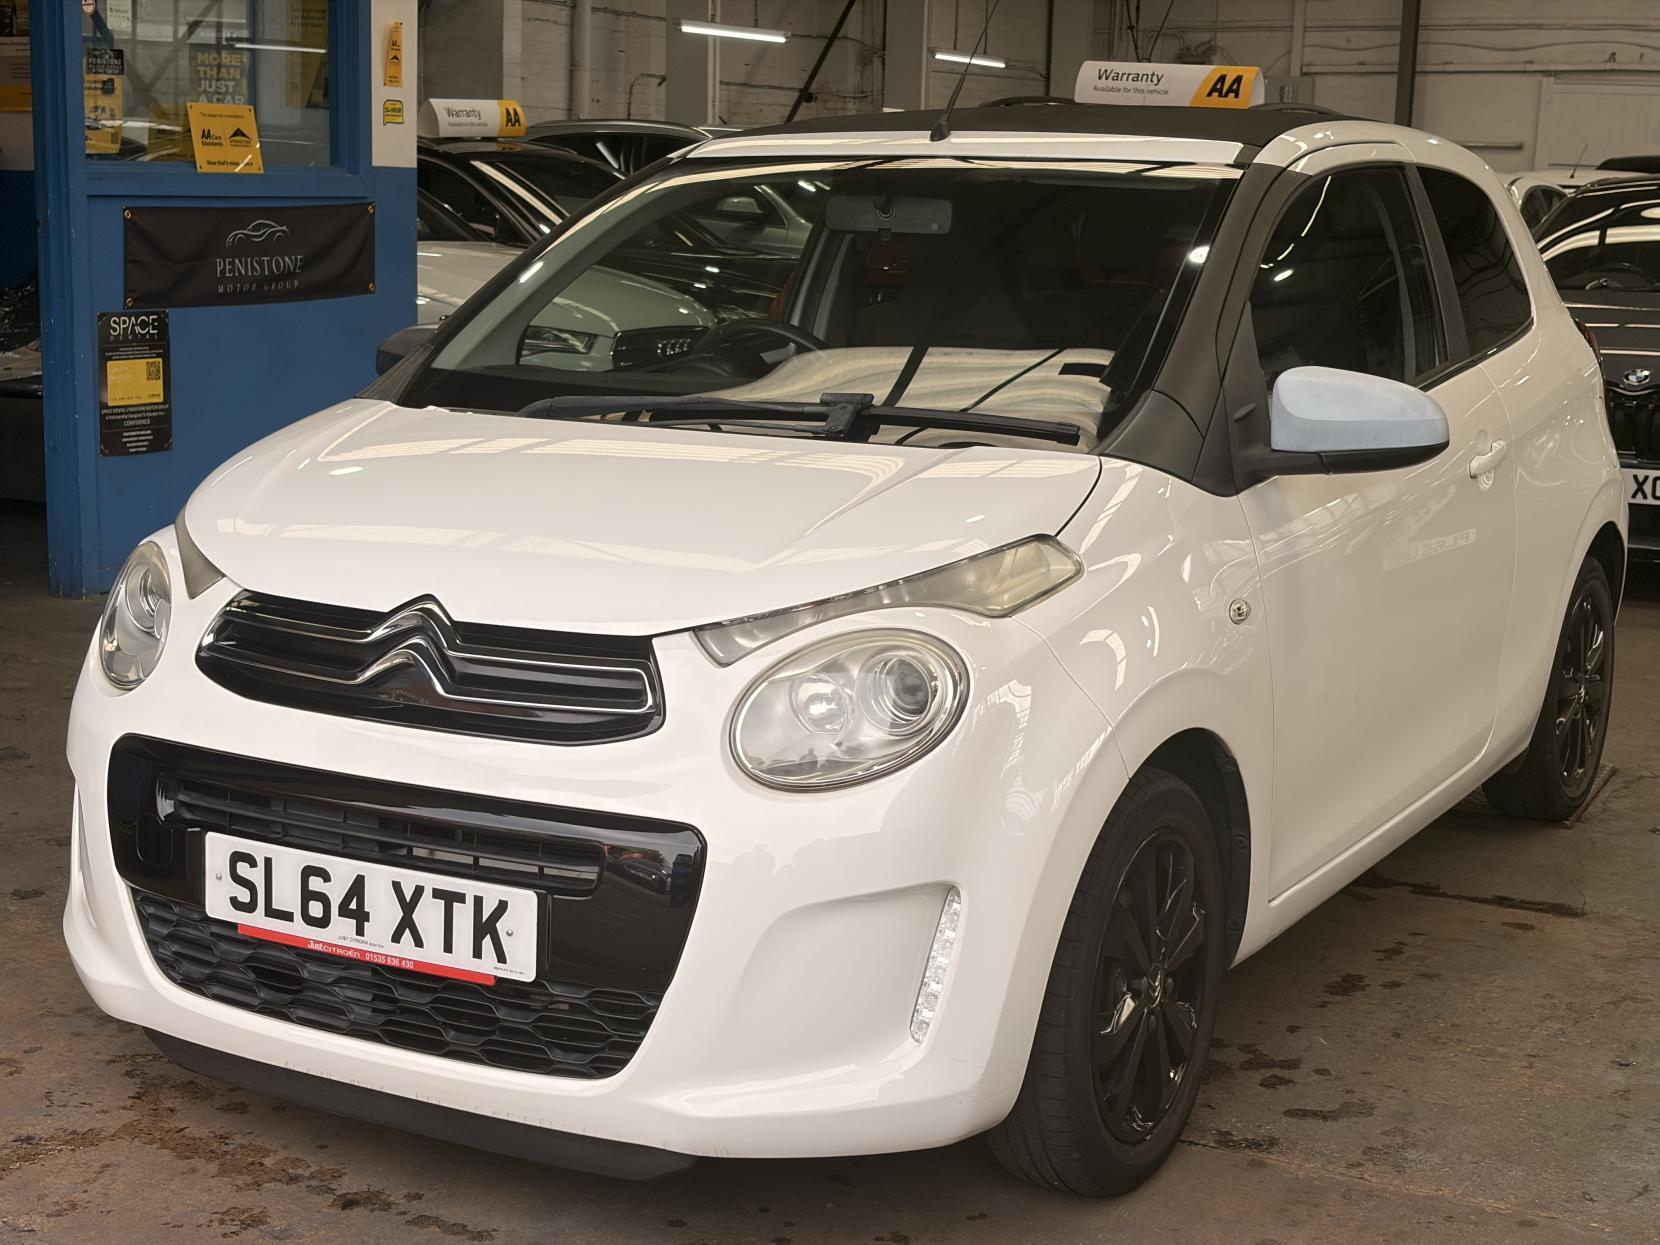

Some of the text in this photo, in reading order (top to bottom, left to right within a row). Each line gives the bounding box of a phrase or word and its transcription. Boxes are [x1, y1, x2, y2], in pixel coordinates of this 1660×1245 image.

[197, 52, 241, 65] MORE
[198, 66, 241, 79] THAN
[1097, 69, 1164, 86] Warranty
[198, 80, 236, 93] JUST
[1093, 85, 1121, 93] Available
[1122, 86, 1132, 94] for
[1146, 88, 1169, 96] vehicle
[1206, 74, 1243, 99] AA
[444, 106, 481, 120] Warranty
[505, 107, 521, 127] AA
[201, 128, 211, 140] AA
[216, 255, 303, 277] PENISTONE
[218, 279, 299, 294] MOTOR GROUP
[110, 315, 158, 335] SPACE
[366, 952, 385, 963] 01535
[401, 960, 414, 969] 430
